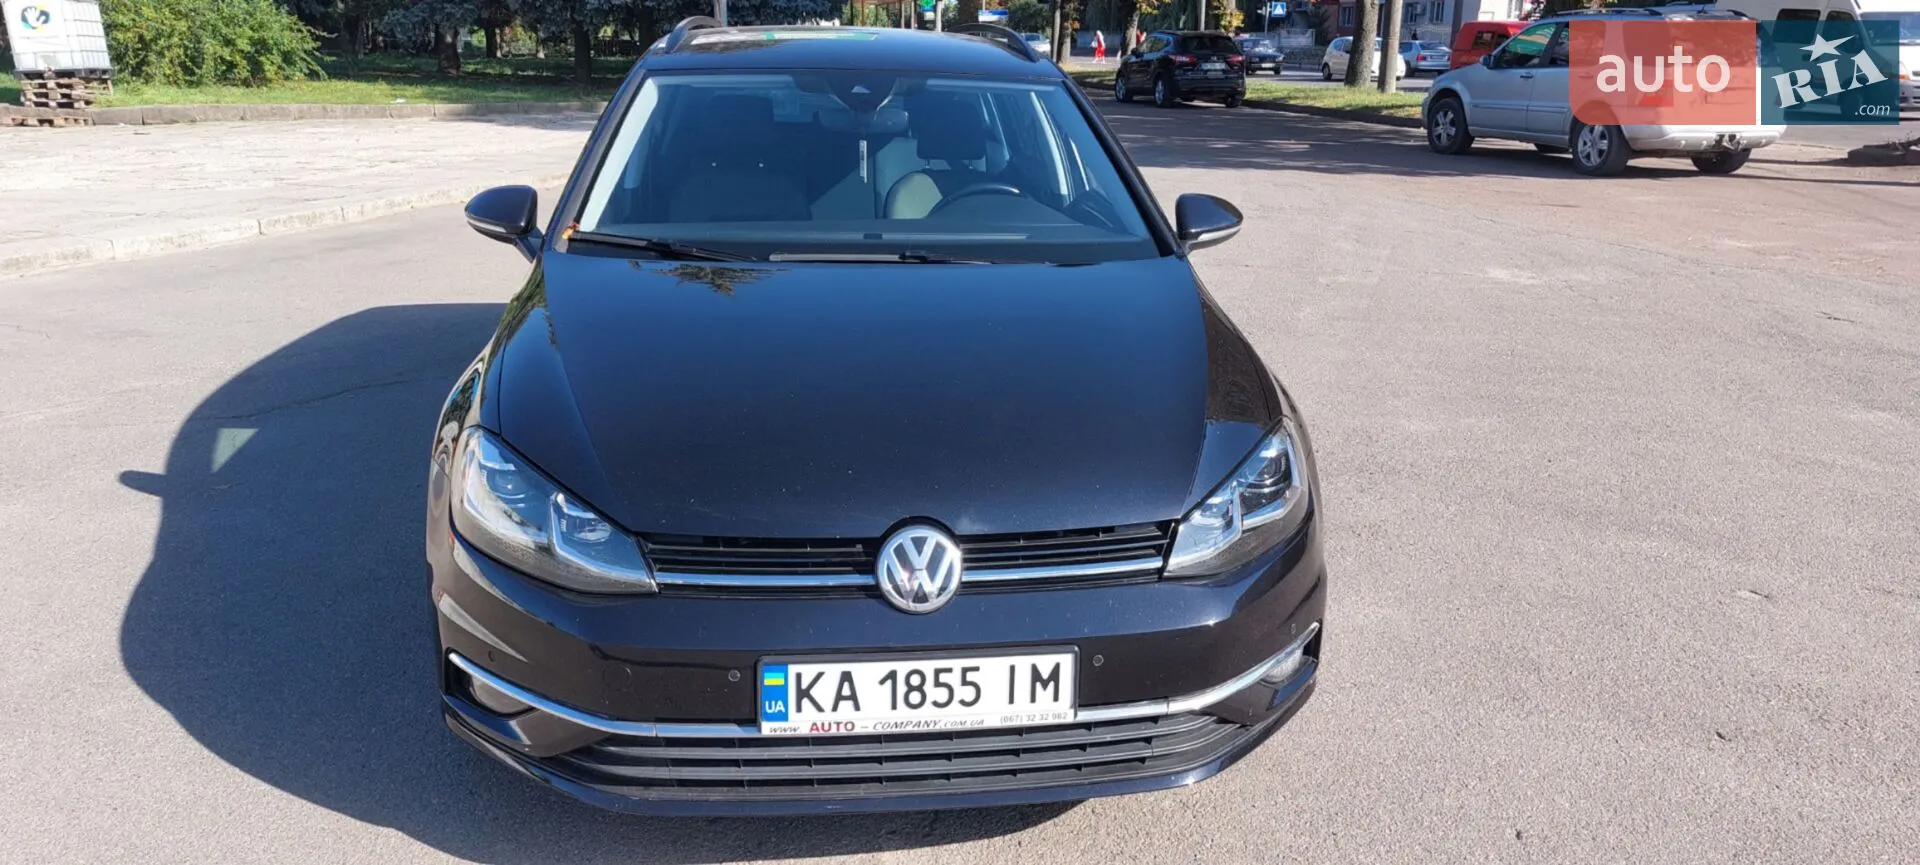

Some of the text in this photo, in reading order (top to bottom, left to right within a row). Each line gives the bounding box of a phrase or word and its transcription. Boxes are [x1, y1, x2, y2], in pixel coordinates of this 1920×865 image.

[795, 662, 1061, 714] KA 1855 IM
[765, 700, 785, 713] UA
[809, 721, 856, 733] AUTO
